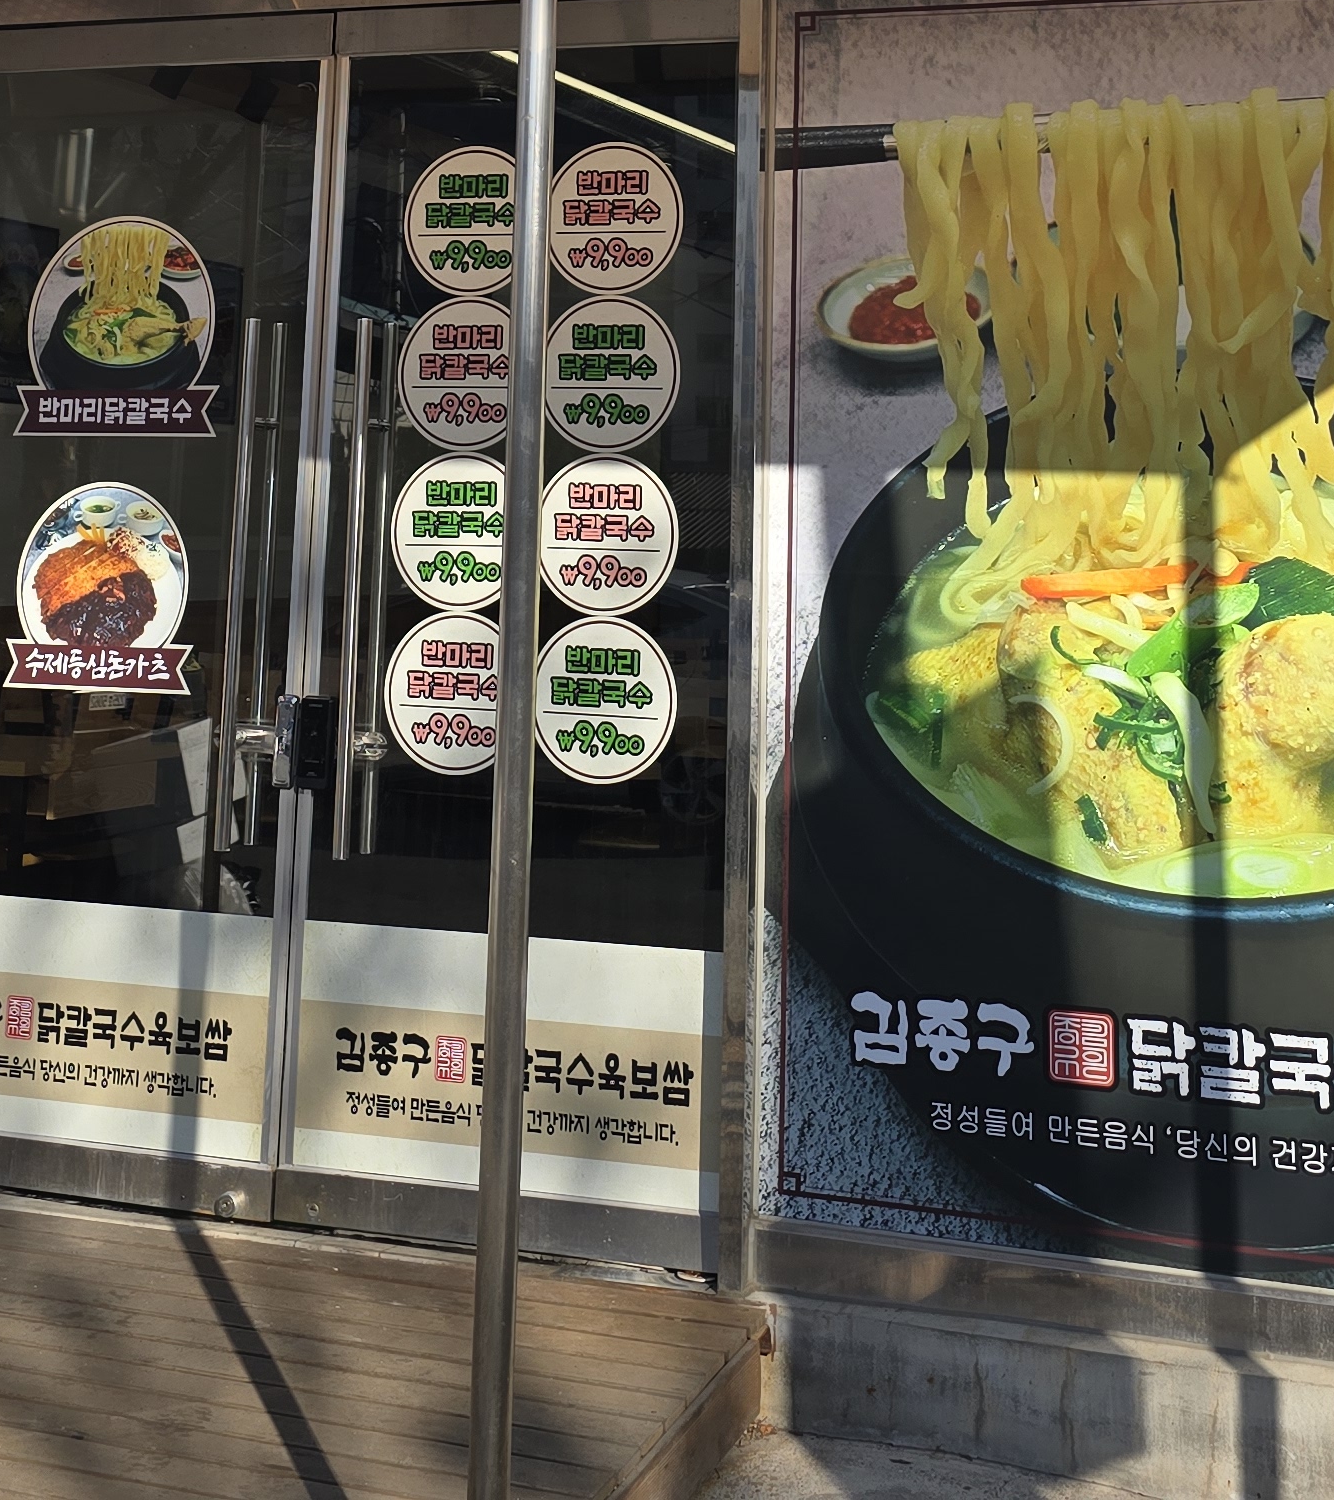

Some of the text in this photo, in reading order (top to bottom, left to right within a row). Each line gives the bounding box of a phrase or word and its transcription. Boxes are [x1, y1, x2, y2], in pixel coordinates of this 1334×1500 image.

[439, 174, 509, 198] 반마리
[577, 170, 649, 195] 반마리
[425, 203, 514, 228] 닭칼국수
[563, 199, 660, 226] 닭칼국수
[433, 324, 503, 349] 반마리
[572, 324, 645, 350] 반마리
[419, 354, 508, 380] 닭칼국수
[558, 354, 657, 381] 닭칼국수
[38, 397, 192, 425] 반마리닭칼국수
[426, 480, 497, 506] 반마리
[569, 482, 642, 510] 반마리
[412, 511, 504, 538] 닭칼국수
[554, 513, 655, 542] 닭칼국수
[25, 647, 171, 680] 수제등심돈카츠
[422, 639, 494, 668] 반마리
[565, 646, 641, 675] 반마리
[407, 671, 498, 700] 닭칼국수
[551, 677, 653, 708] 닭칼국수
[37, 1001, 233, 1061] 닭칼국수육보쌈
[850, 989, 1037, 1078] 김종구
[39, 1059, 81, 1084] 당신의
[84, 1064, 139, 1089] 건강까지
[143, 1069, 217, 1098] 생각합니다.
[336, 1027, 431, 1079] 김종구
[471, 1042, 694, 1107] 국수육보쌈
[346, 1091, 406, 1118] 정성들여
[410, 1098, 471, 1126] 만든음식
[527, 1110, 679, 1147] 건강까지 생각합니다.
[930, 1101, 1036, 1142] 정성들여
[1047, 1113, 1157, 1155] 만든음식
